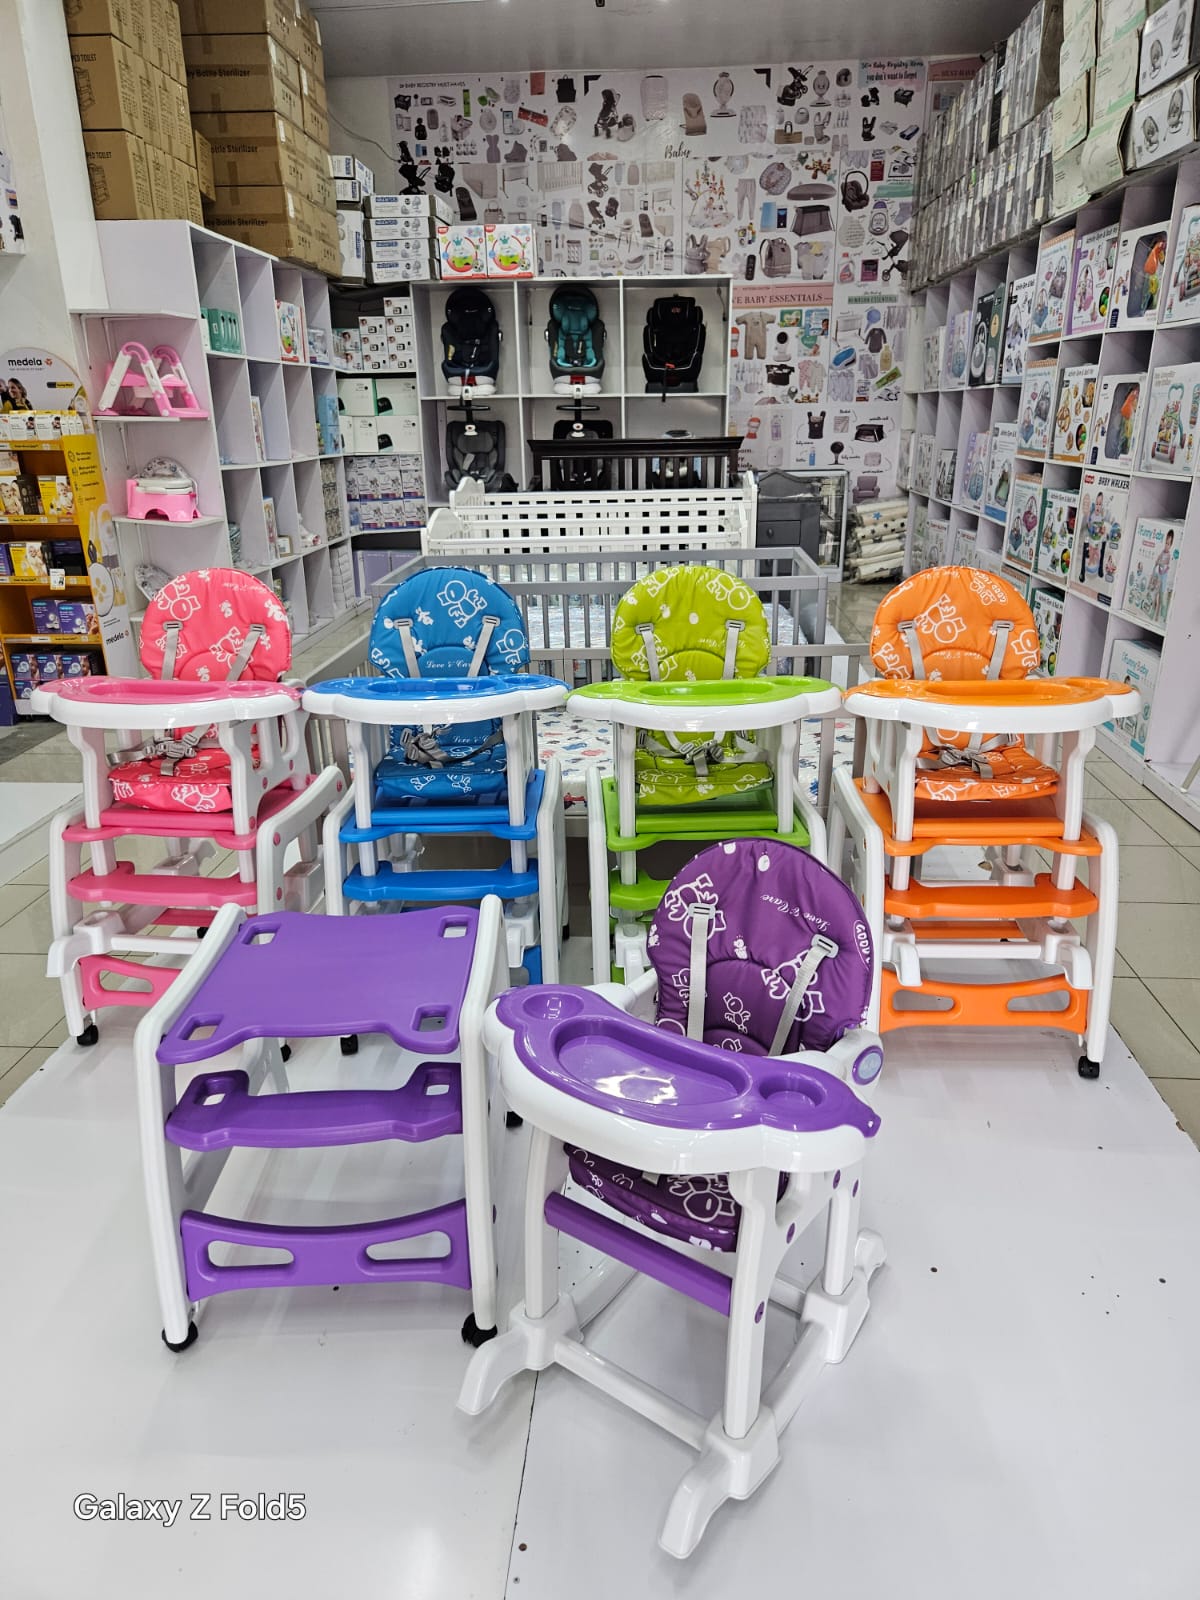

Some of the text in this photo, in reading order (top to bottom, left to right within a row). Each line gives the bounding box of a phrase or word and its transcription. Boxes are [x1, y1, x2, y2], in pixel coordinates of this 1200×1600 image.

[218, 68, 250, 77] Sterilizer
[211, 144, 258, 153] ottle Sterilizer
[664, 140, 690, 159] Baby
[237, 218, 268, 226] Sterilizer
[744, 295, 766, 304] BABY
[769, 293, 823, 304] ESSENTIALS
[8, 356, 42, 366] medela
[1098, 476, 1110, 486] BABY
[1110, 478, 1130, 490] WALKER
[106, 632, 124, 645] medela
[426, 660, 445, 669] Love
[456, 660, 473, 669] Car
[760, 894, 830, 932] Love & Care
